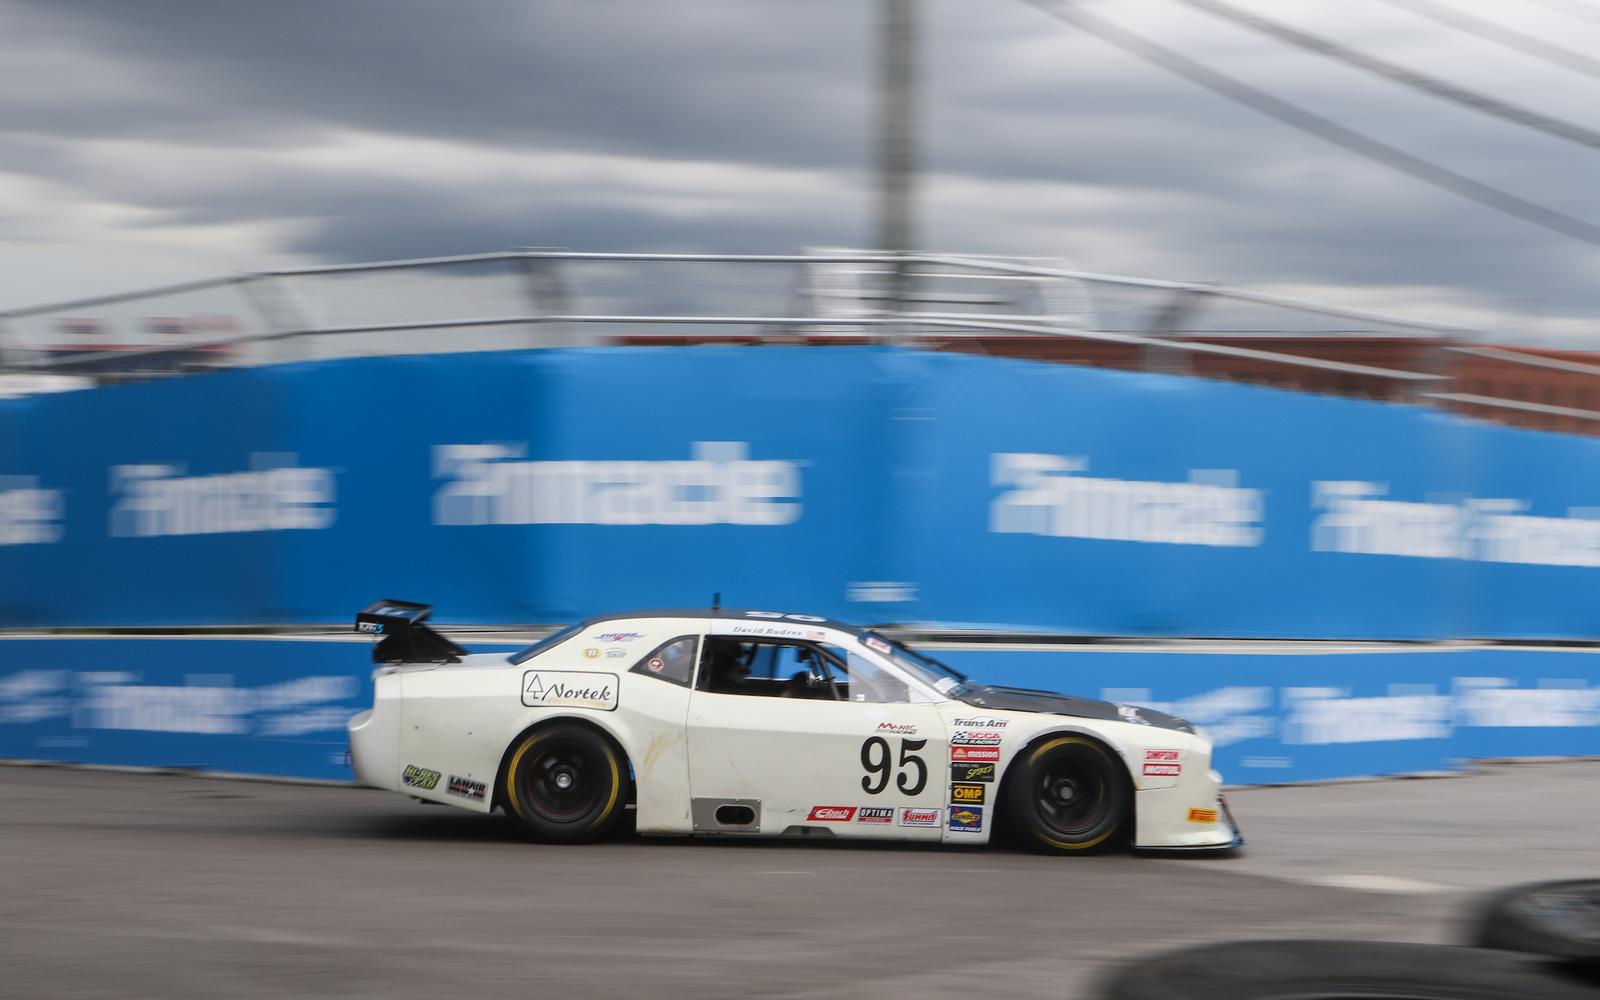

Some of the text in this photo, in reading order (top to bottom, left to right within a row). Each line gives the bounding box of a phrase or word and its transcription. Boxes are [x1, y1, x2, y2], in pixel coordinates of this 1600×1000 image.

[541, 683, 610, 701] Nortek
[954, 718, 1007, 728] Trans Am
[861, 736, 928, 796] 95
[953, 788, 983, 799] OMP
[860, 808, 892, 817] OPTIMA
